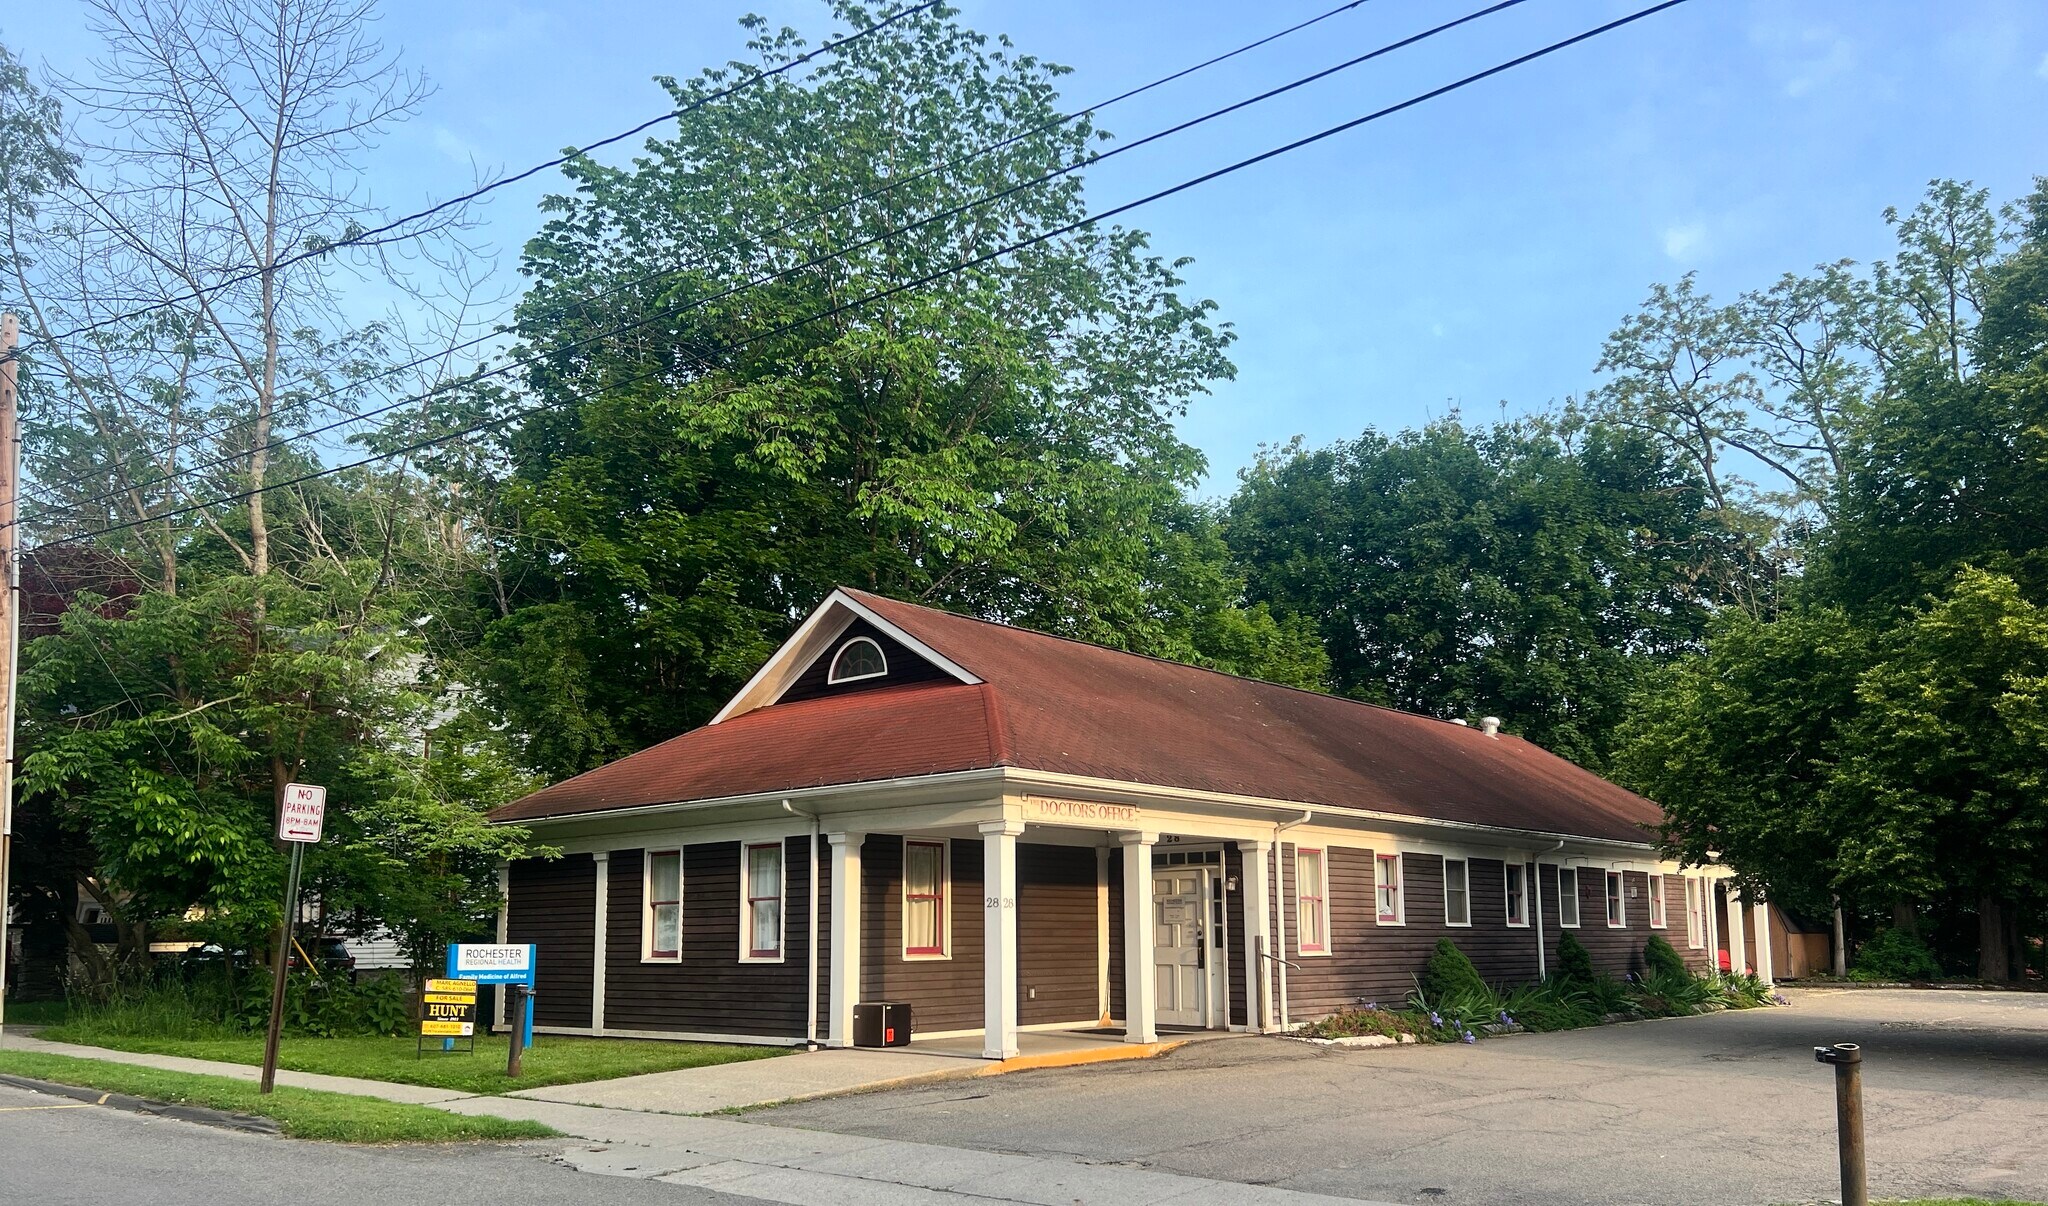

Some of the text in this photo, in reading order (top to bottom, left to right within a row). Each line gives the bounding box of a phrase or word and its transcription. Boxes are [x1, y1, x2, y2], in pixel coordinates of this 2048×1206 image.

[298, 789, 313, 800] NO
[286, 802, 321, 815] PARKING
[1099, 805, 1134, 821] OFFICE
[986, 897, 999, 908] 28
[1003, 897, 1014, 909] 28
[465, 949, 522, 958] ROCHESTER
[429, 1004, 469, 1017] HUNT
